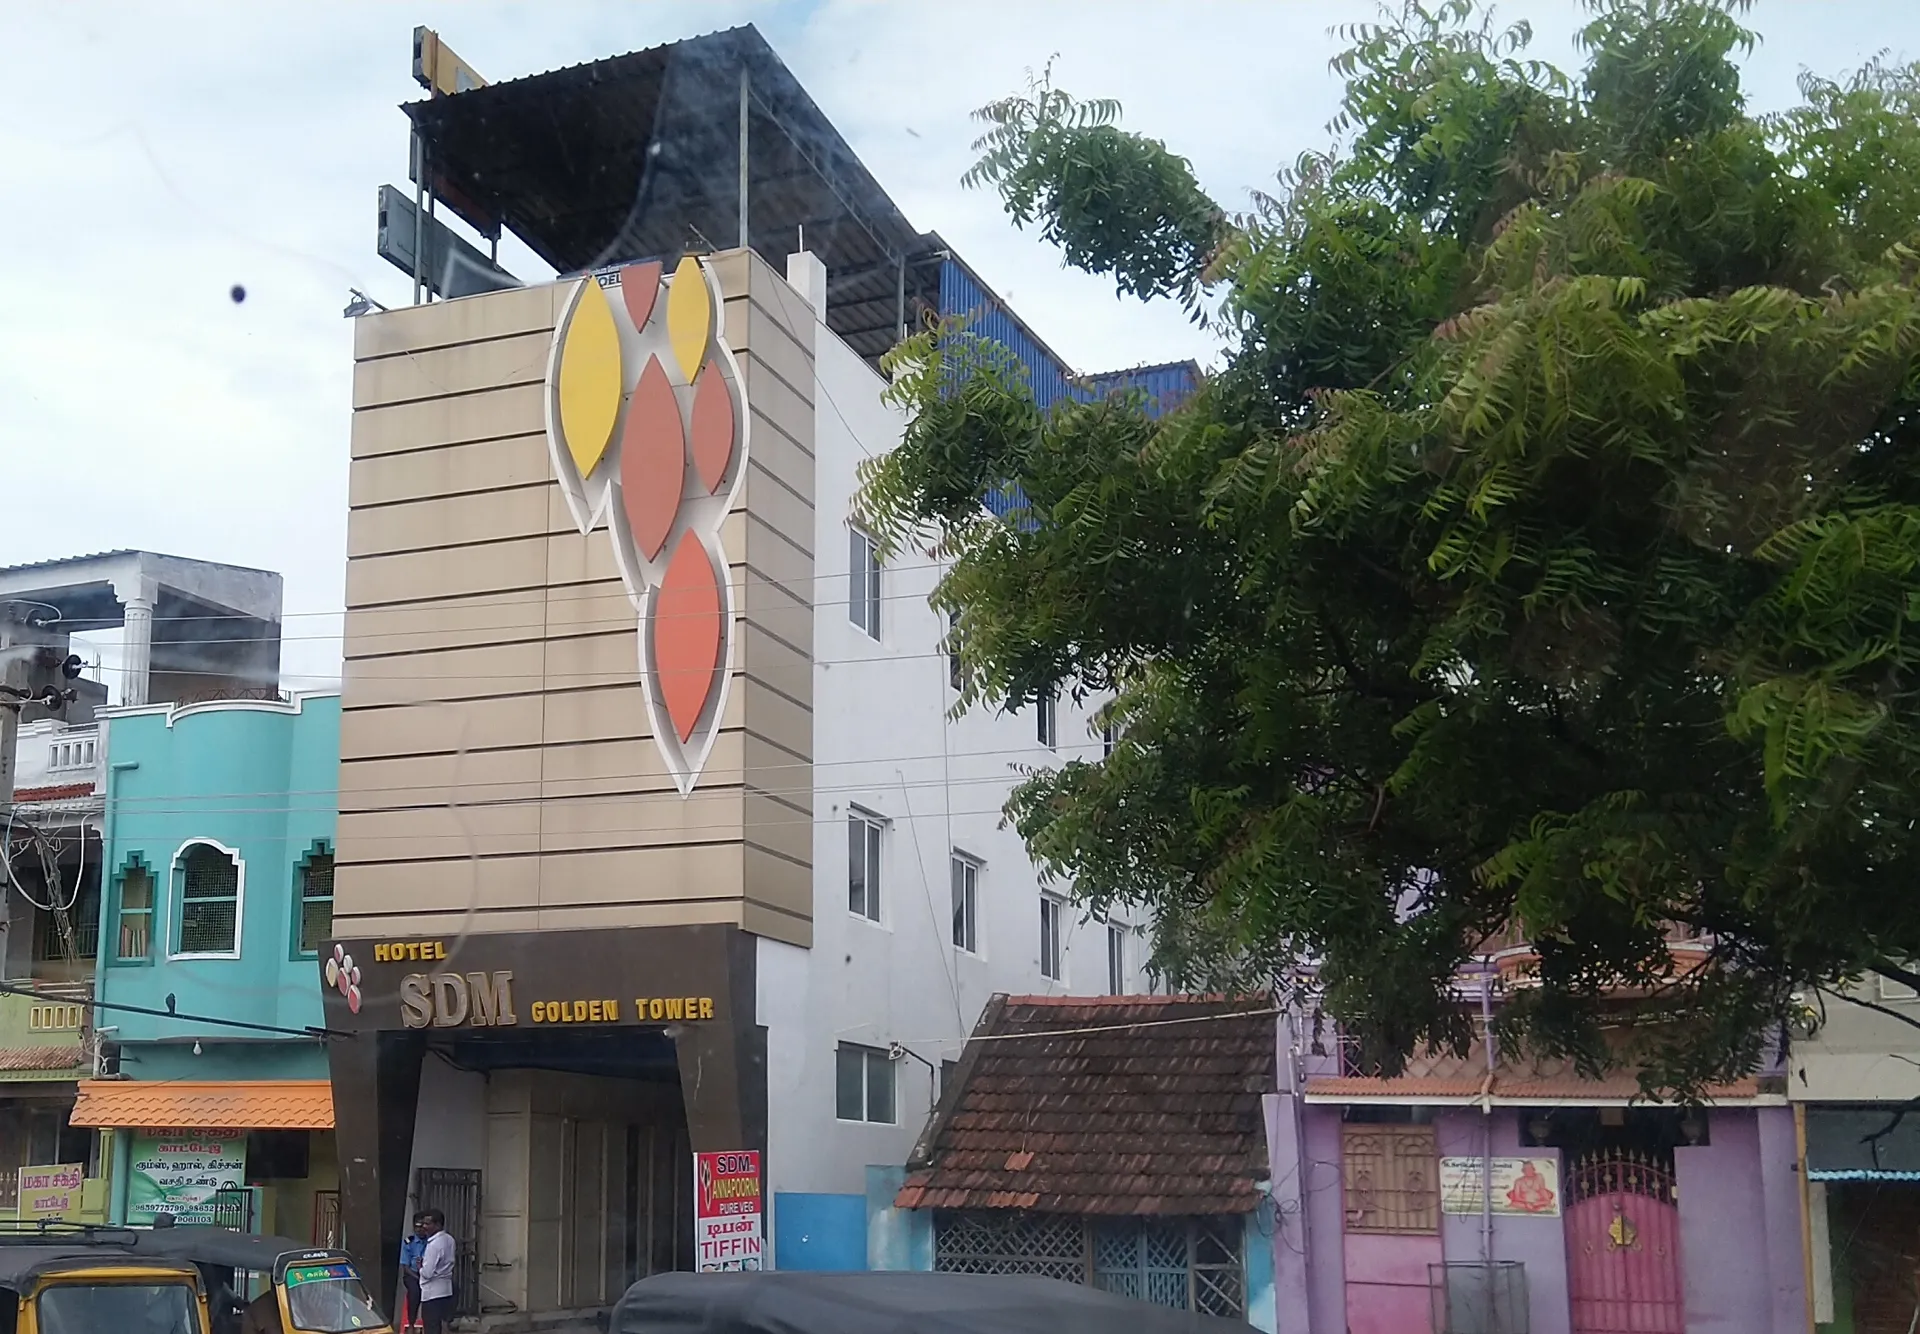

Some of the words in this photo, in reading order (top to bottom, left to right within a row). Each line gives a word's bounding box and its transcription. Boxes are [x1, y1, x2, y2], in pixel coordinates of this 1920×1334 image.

[597, 274, 622, 286] OEL
[374, 941, 448, 962] HOTEL
[400, 970, 517, 1029] SDM
[531, 1000, 619, 1023] GOLDEN
[635, 997, 714, 1020] TOWER
[717, 1155, 751, 1174] SDM
[23, 1175, 49, 1188] மகா
[52, 1166, 80, 1189] சக்தி
[159, 1175, 184, 1186] வசதி
[186, 1175, 217, 1187] உண்டு
[712, 1178, 760, 1200] ANNAPOORNA
[719, 1202, 739, 1214] PURE
[740, 1201, 754, 1213] VEG
[707, 1215, 755, 1239] டிபன்
[700, 1236, 760, 1260] TIFFIN
